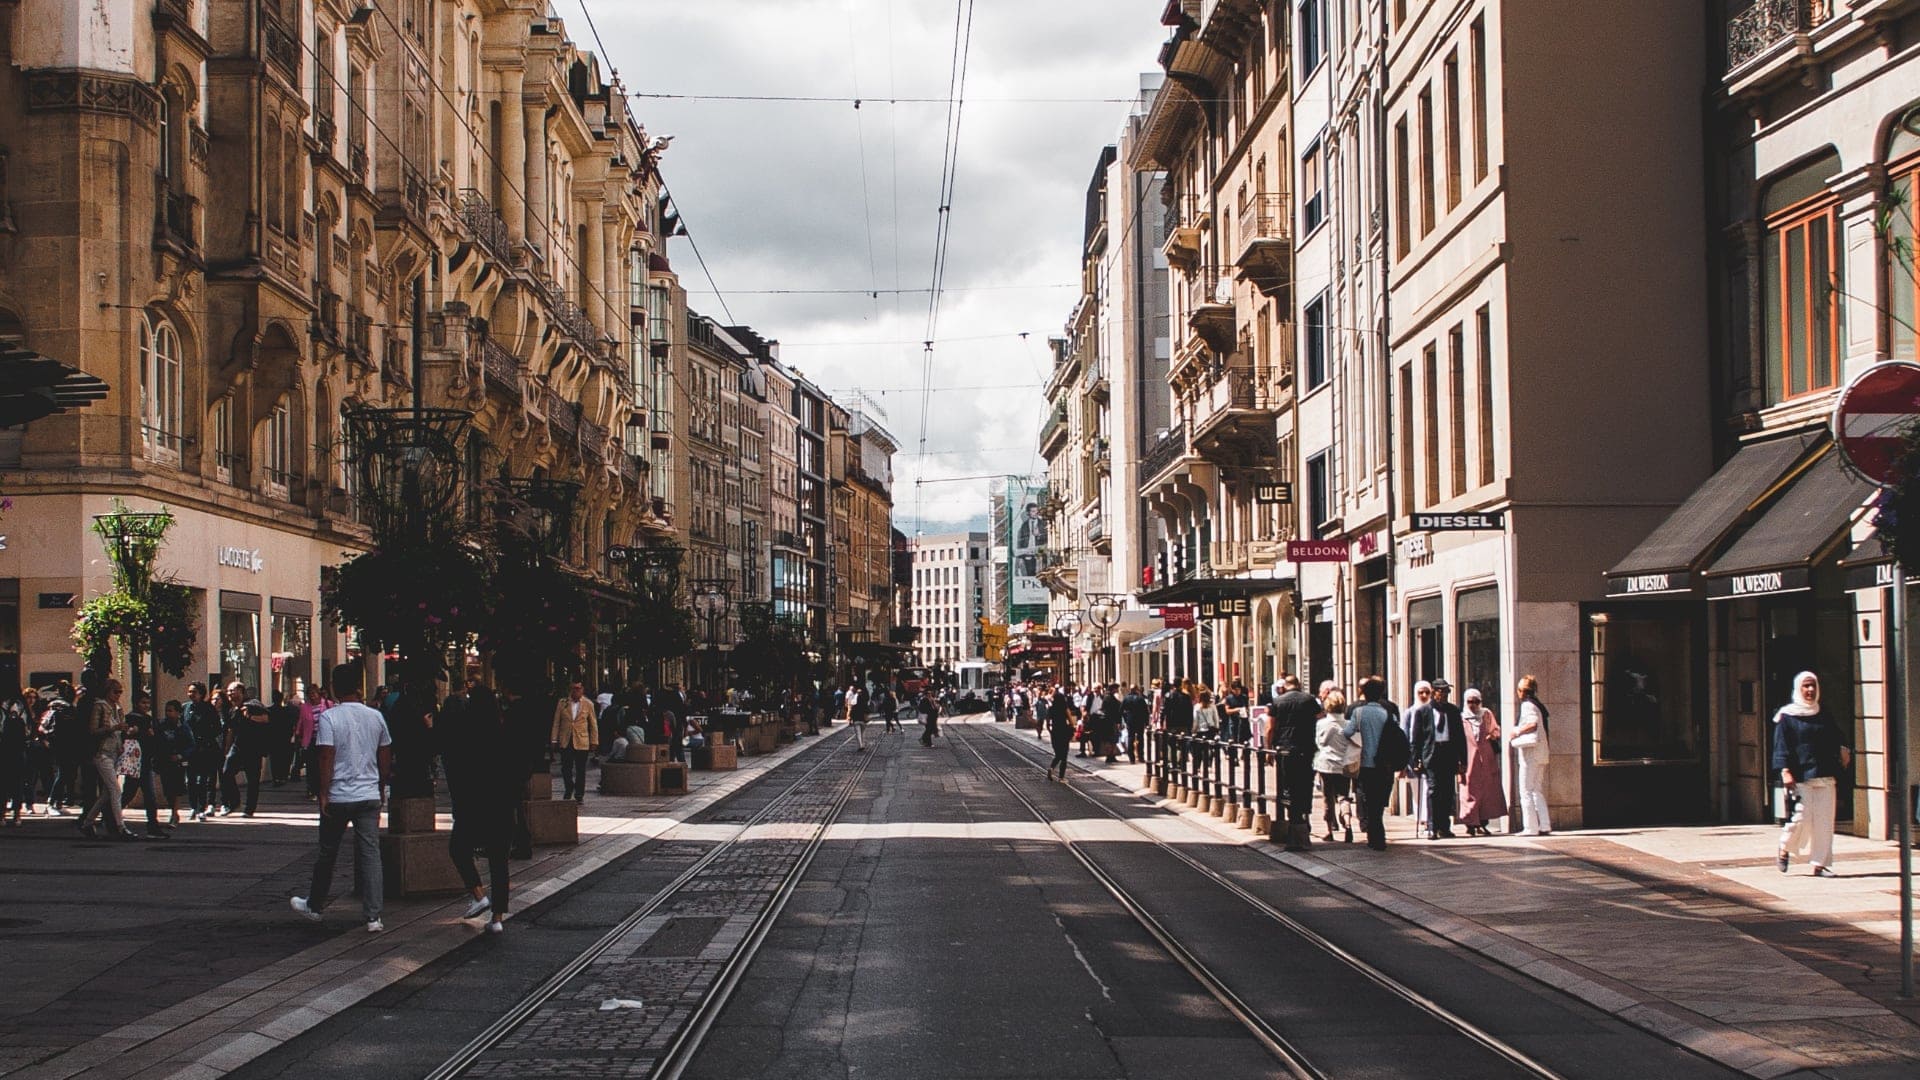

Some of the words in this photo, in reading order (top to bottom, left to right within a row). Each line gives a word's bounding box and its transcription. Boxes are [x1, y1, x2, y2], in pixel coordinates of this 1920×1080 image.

[1259, 486, 1288, 500] WE
[1418, 516, 1493, 528] DIESEL
[219, 546, 250, 569] LACOSTE
[1209, 540, 1278, 571] WE
[1292, 546, 1347, 556] BELDONA
[1022, 579, 1045, 589] PK
[1638, 574, 1669, 591] WESTON
[1745, 572, 1782, 592] WESTON
[1202, 603, 1214, 616] W
[1219, 599, 1247, 613] WE
[1166, 612, 1193, 622] ESPRIT
